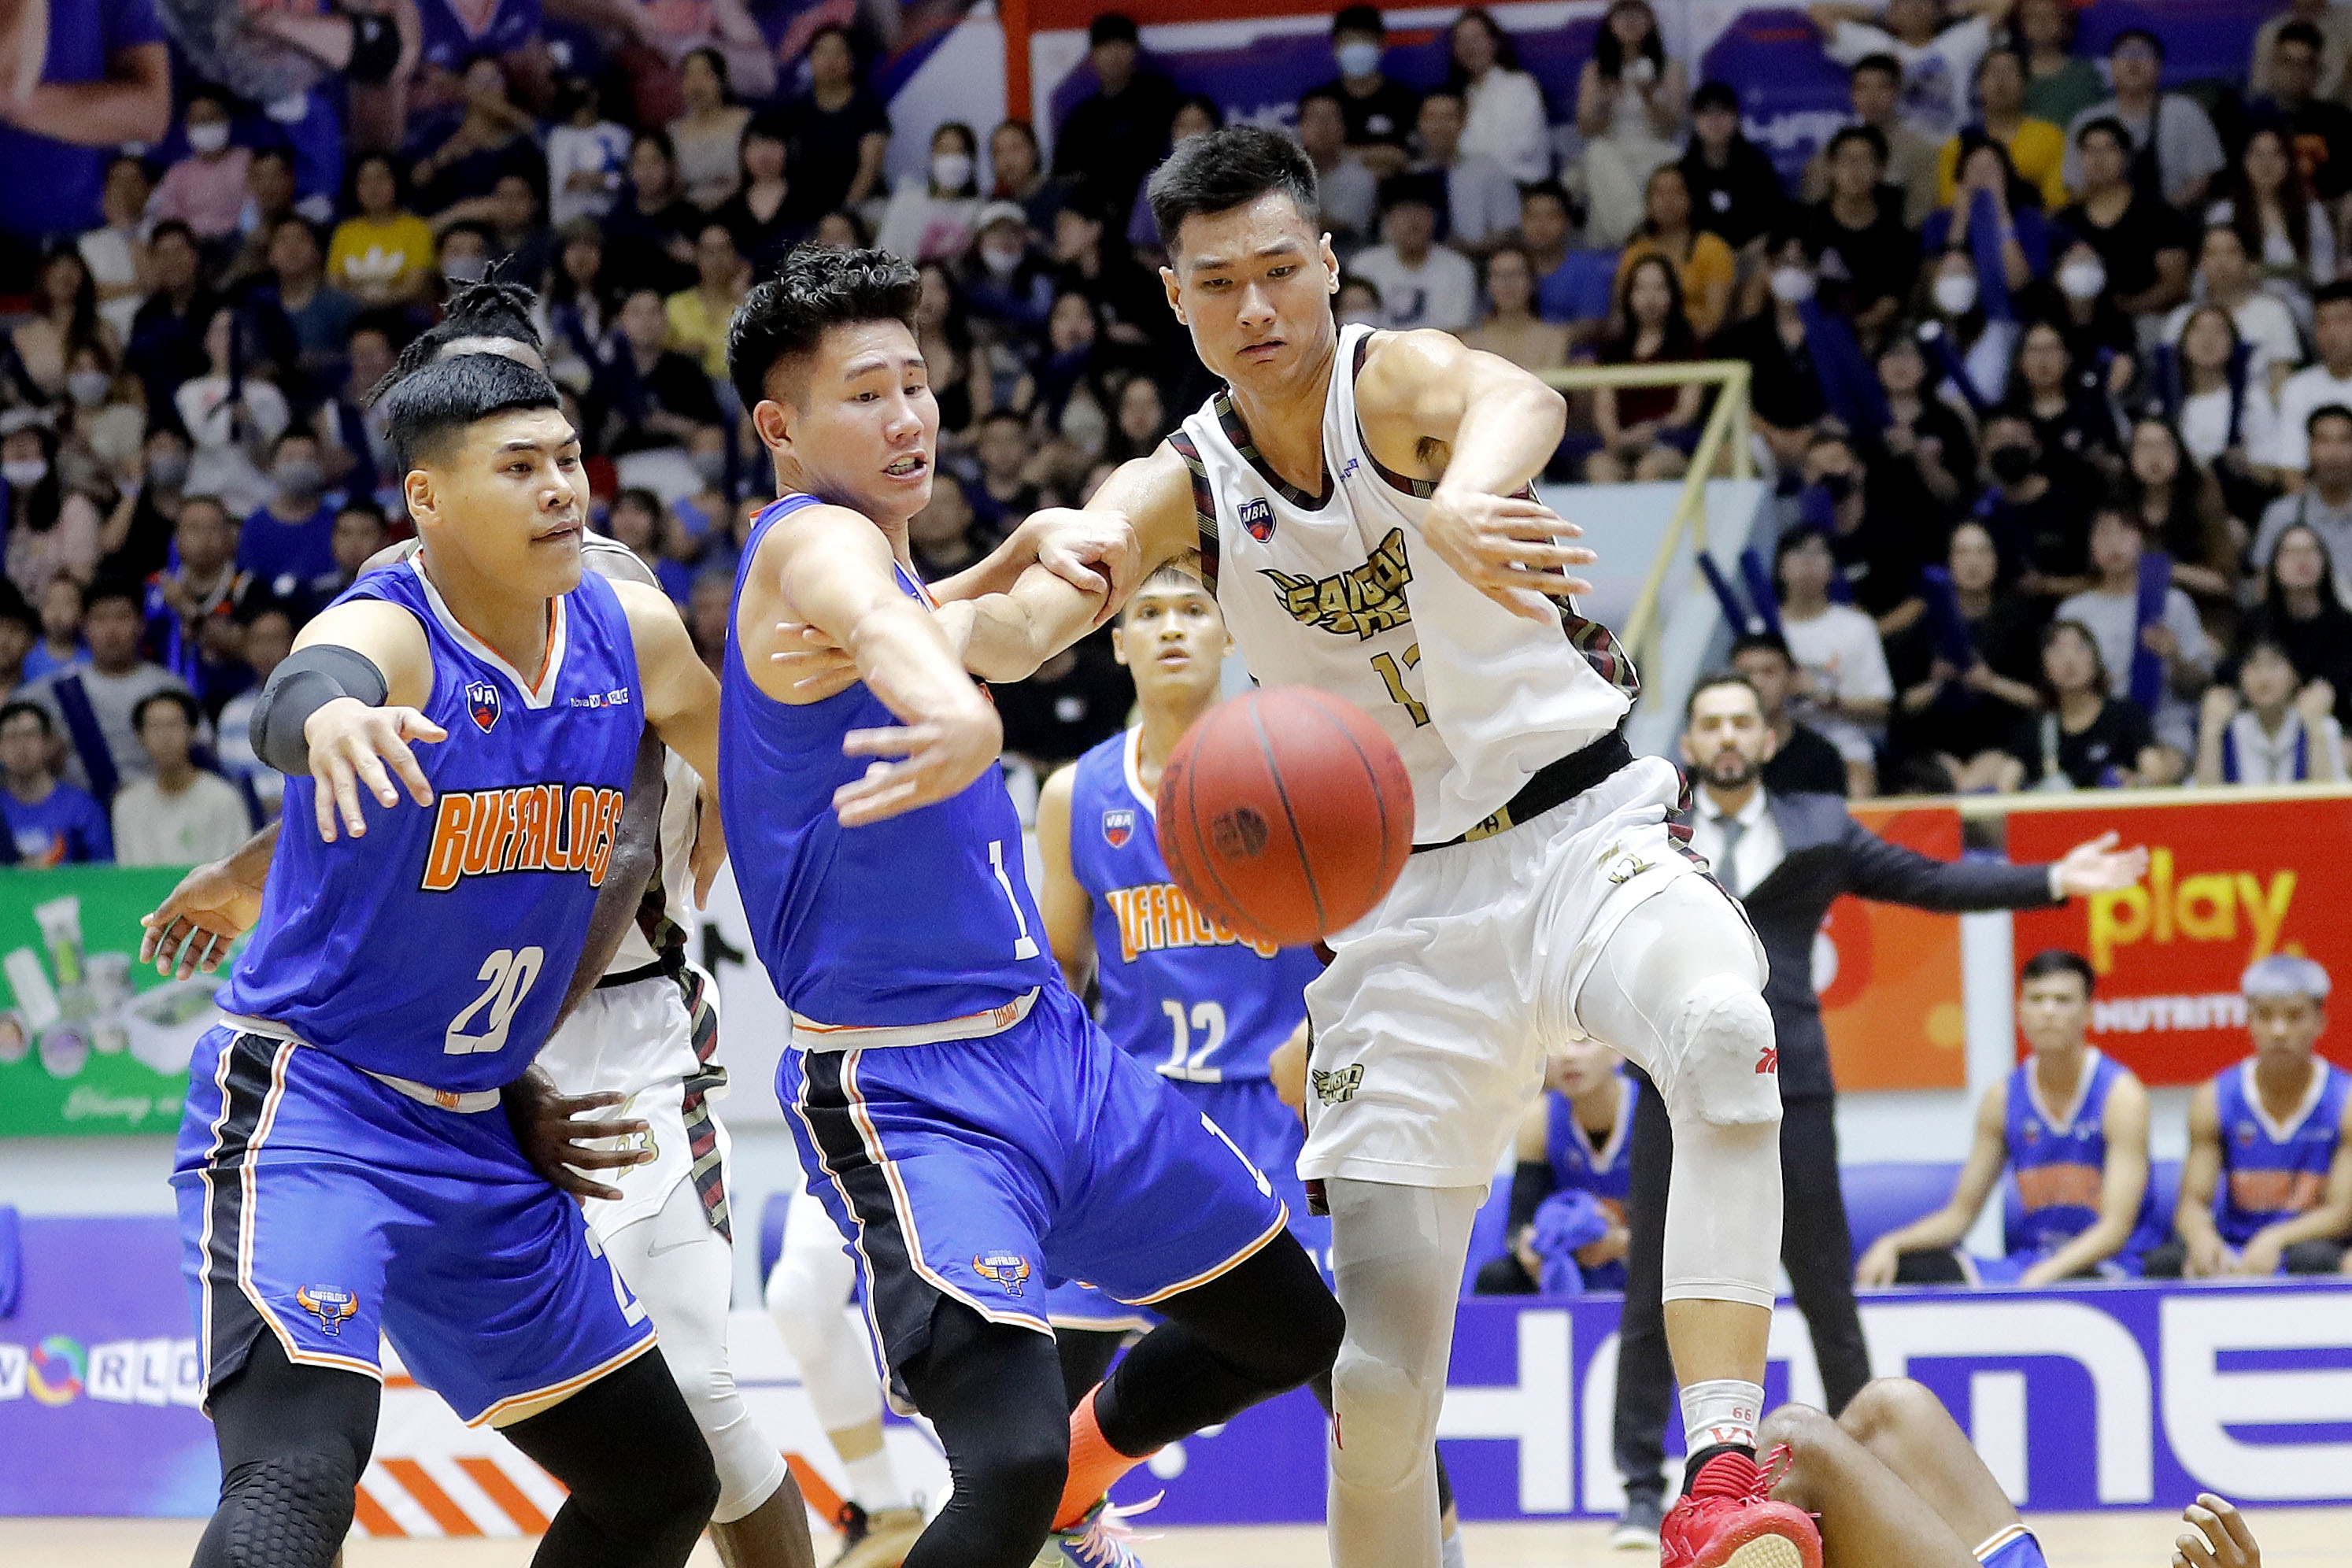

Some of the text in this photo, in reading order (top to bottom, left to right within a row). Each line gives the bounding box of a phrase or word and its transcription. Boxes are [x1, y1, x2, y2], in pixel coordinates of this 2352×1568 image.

[1242, 503, 1270, 523] VBA
[1370, 642, 1430, 728] 1
[420, 784, 623, 888] BUFFALOES
[1106, 814, 1131, 827] VBA
[988, 839, 1041, 961] 1
[2088, 846, 2298, 975] play
[442, 945, 545, 1056] 20
[1155, 999, 1226, 1084] 12
[1200, 1111, 1273, 1199] 1
[309, 1290, 347, 1303] BUFFALOES
[984, 1256, 1021, 1266] BUFFALOES
[1733, 1407, 1751, 1421] 66
